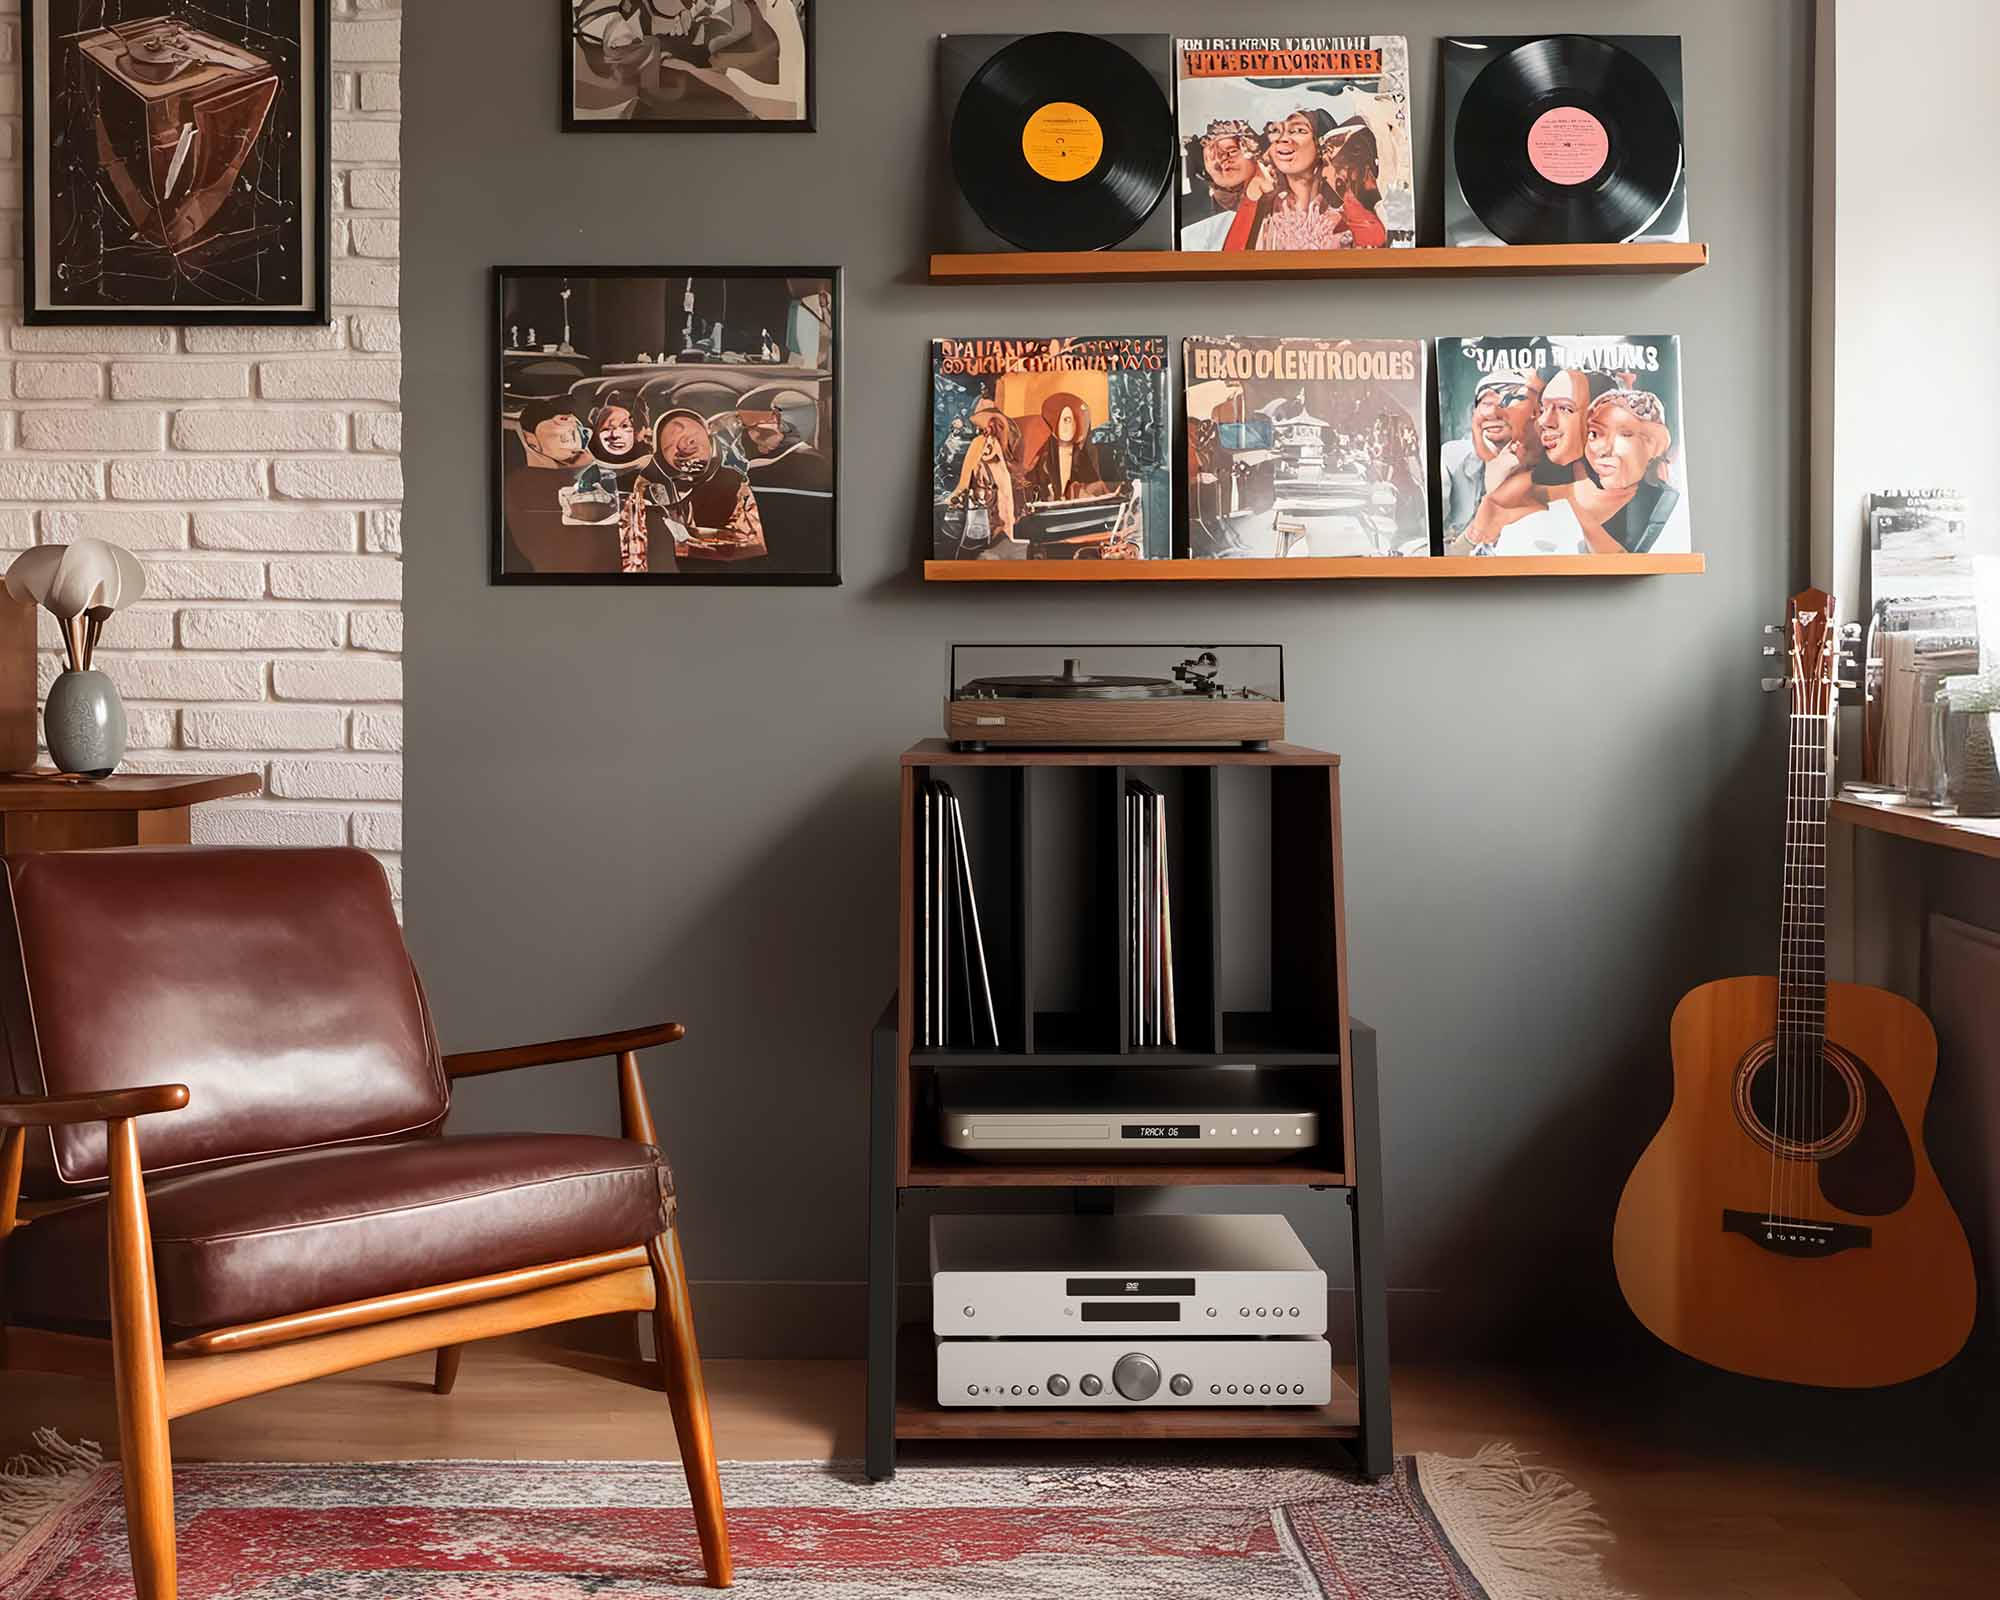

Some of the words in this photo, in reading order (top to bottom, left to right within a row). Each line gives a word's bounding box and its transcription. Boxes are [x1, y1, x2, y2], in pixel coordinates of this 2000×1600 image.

[1140, 1127, 1165, 1136] TRACK
[1168, 1127, 1179, 1136] 06
[1125, 1282, 1139, 1290] DVD
